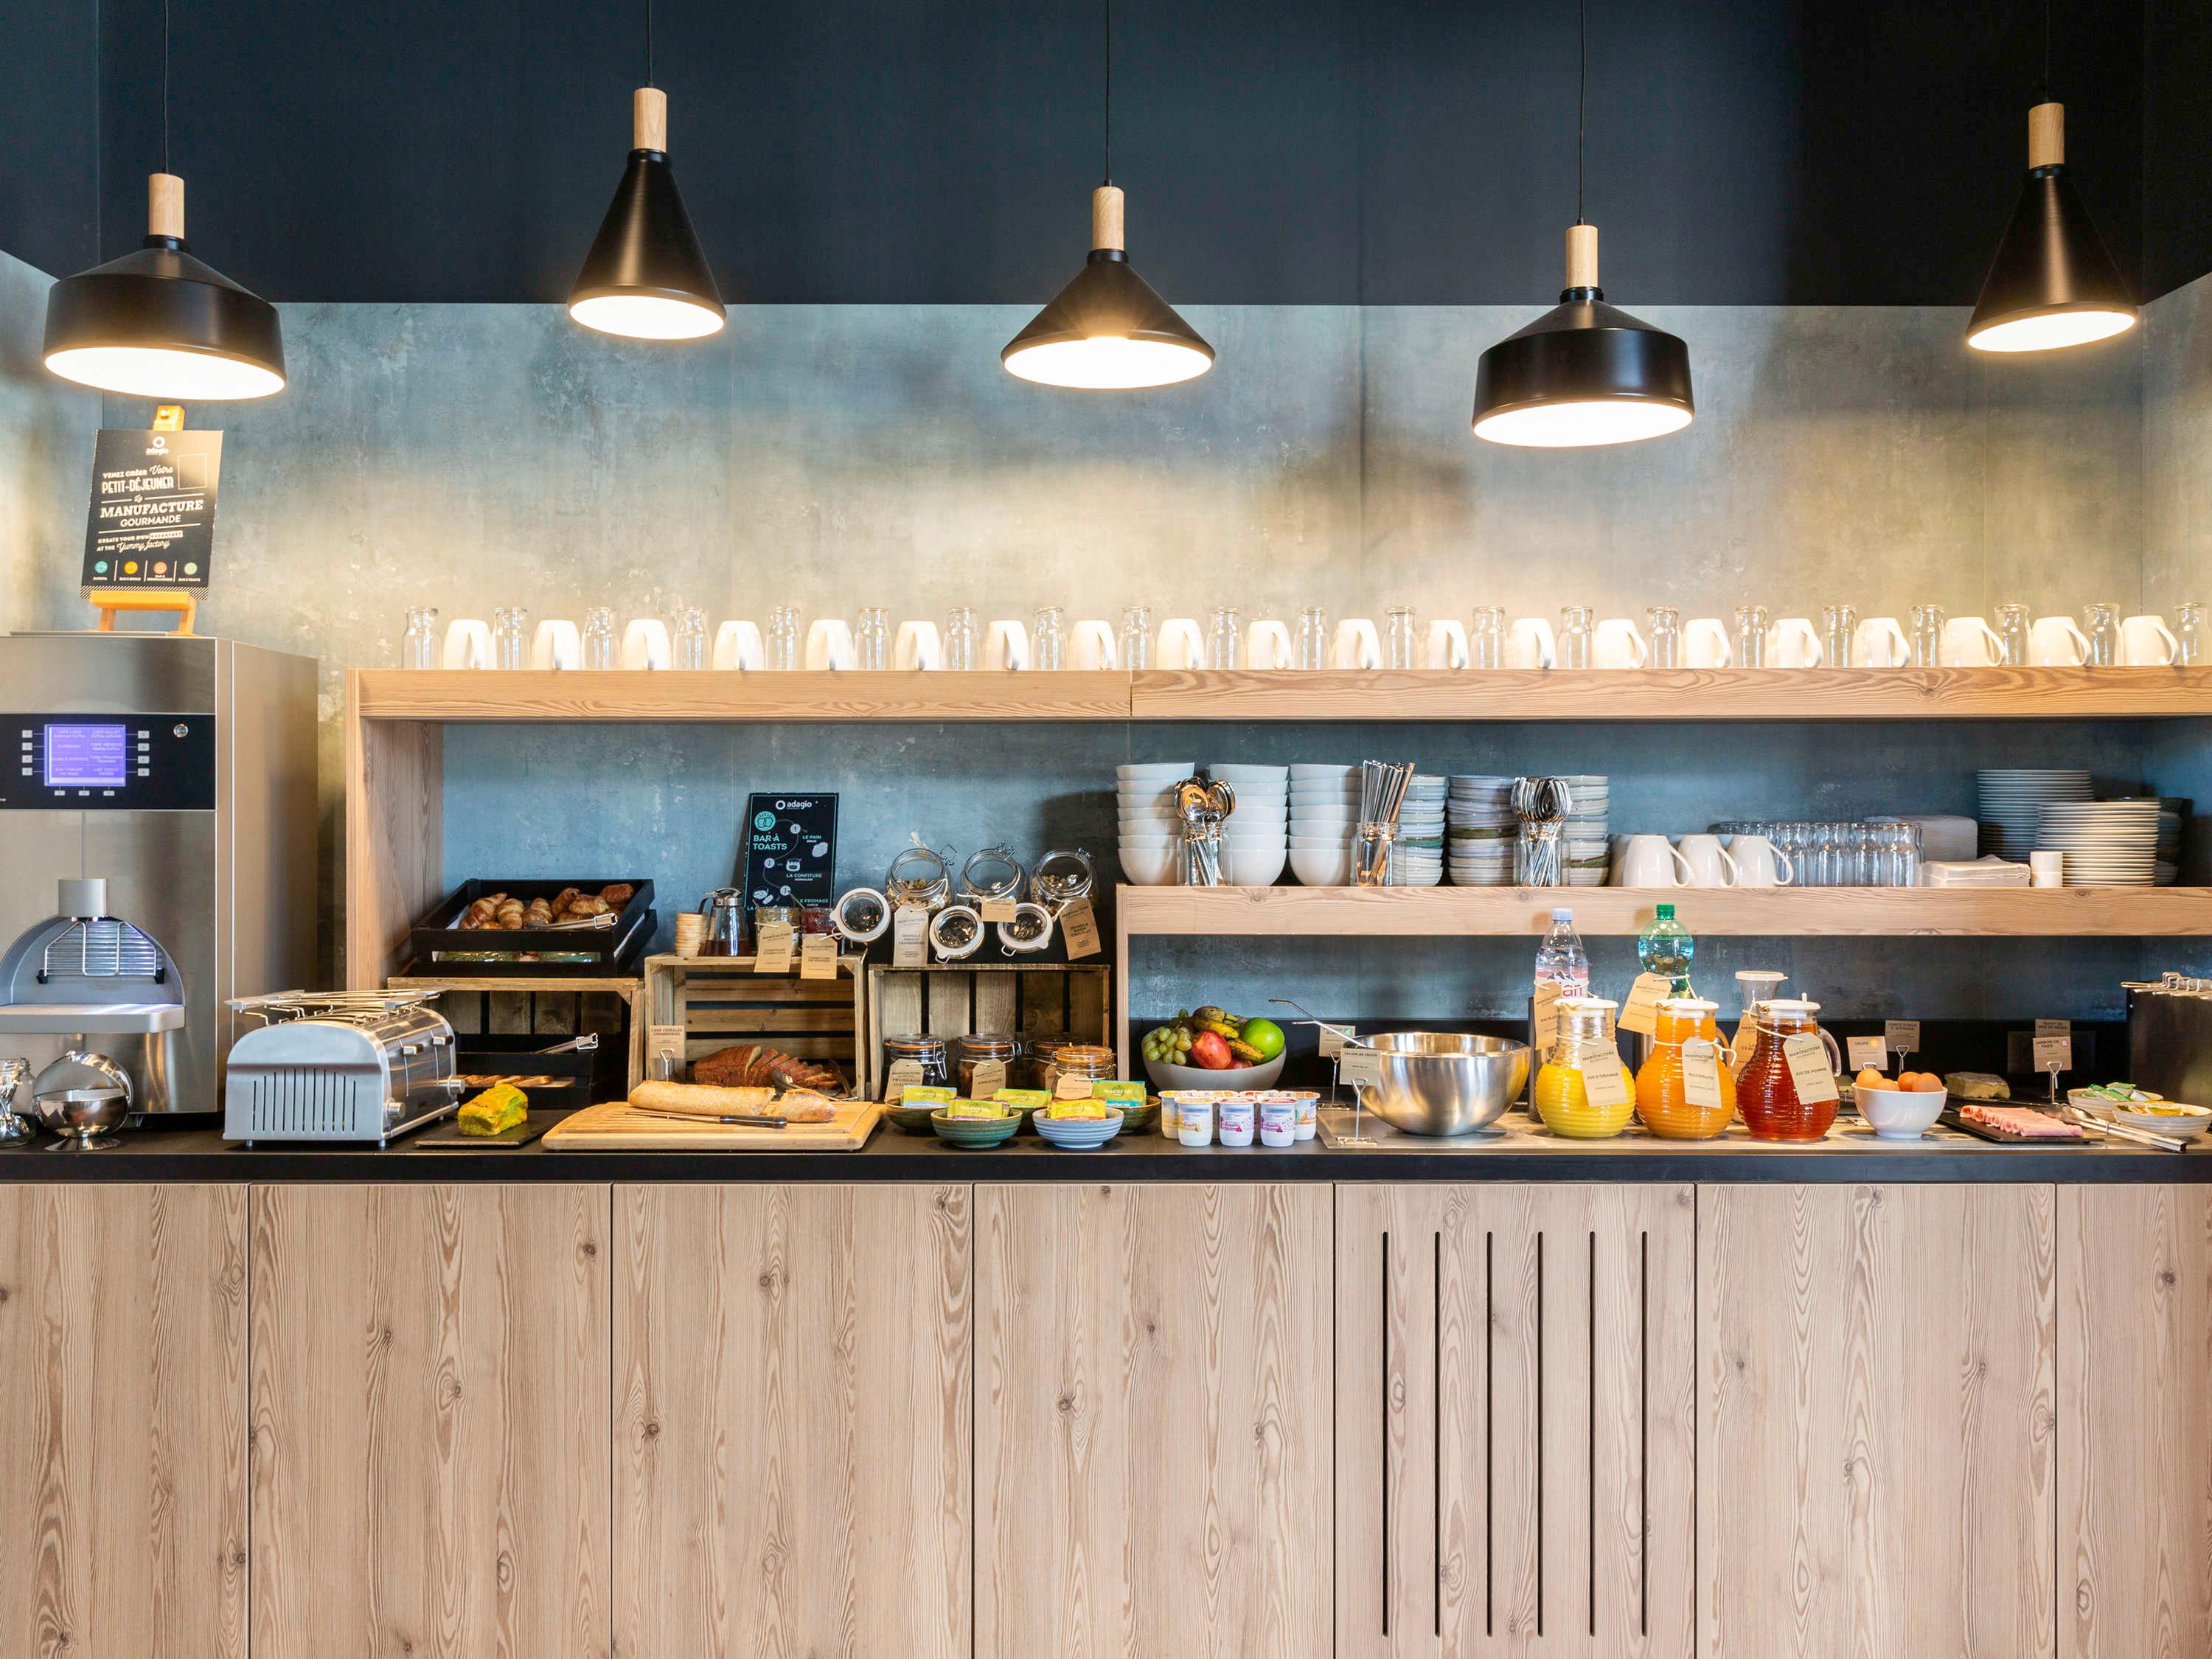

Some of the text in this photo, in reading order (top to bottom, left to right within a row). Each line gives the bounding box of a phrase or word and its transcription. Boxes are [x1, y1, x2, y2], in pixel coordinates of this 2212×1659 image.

[125, 469, 147, 477] CRÉER
[149, 465, 174, 475] Votre
[101, 476, 174, 494] PETIT-DÉJEUNER
[100, 500, 204, 518] MANUFACTURE
[120, 515, 181, 527] GOURMANDE
[97, 536, 119, 544] CREATE
[787, 801, 812, 810] adagio
[1582, 1051, 1615, 1061] MANUFACTURE
[1789, 1046, 1820, 1057] MANUFACTURE
